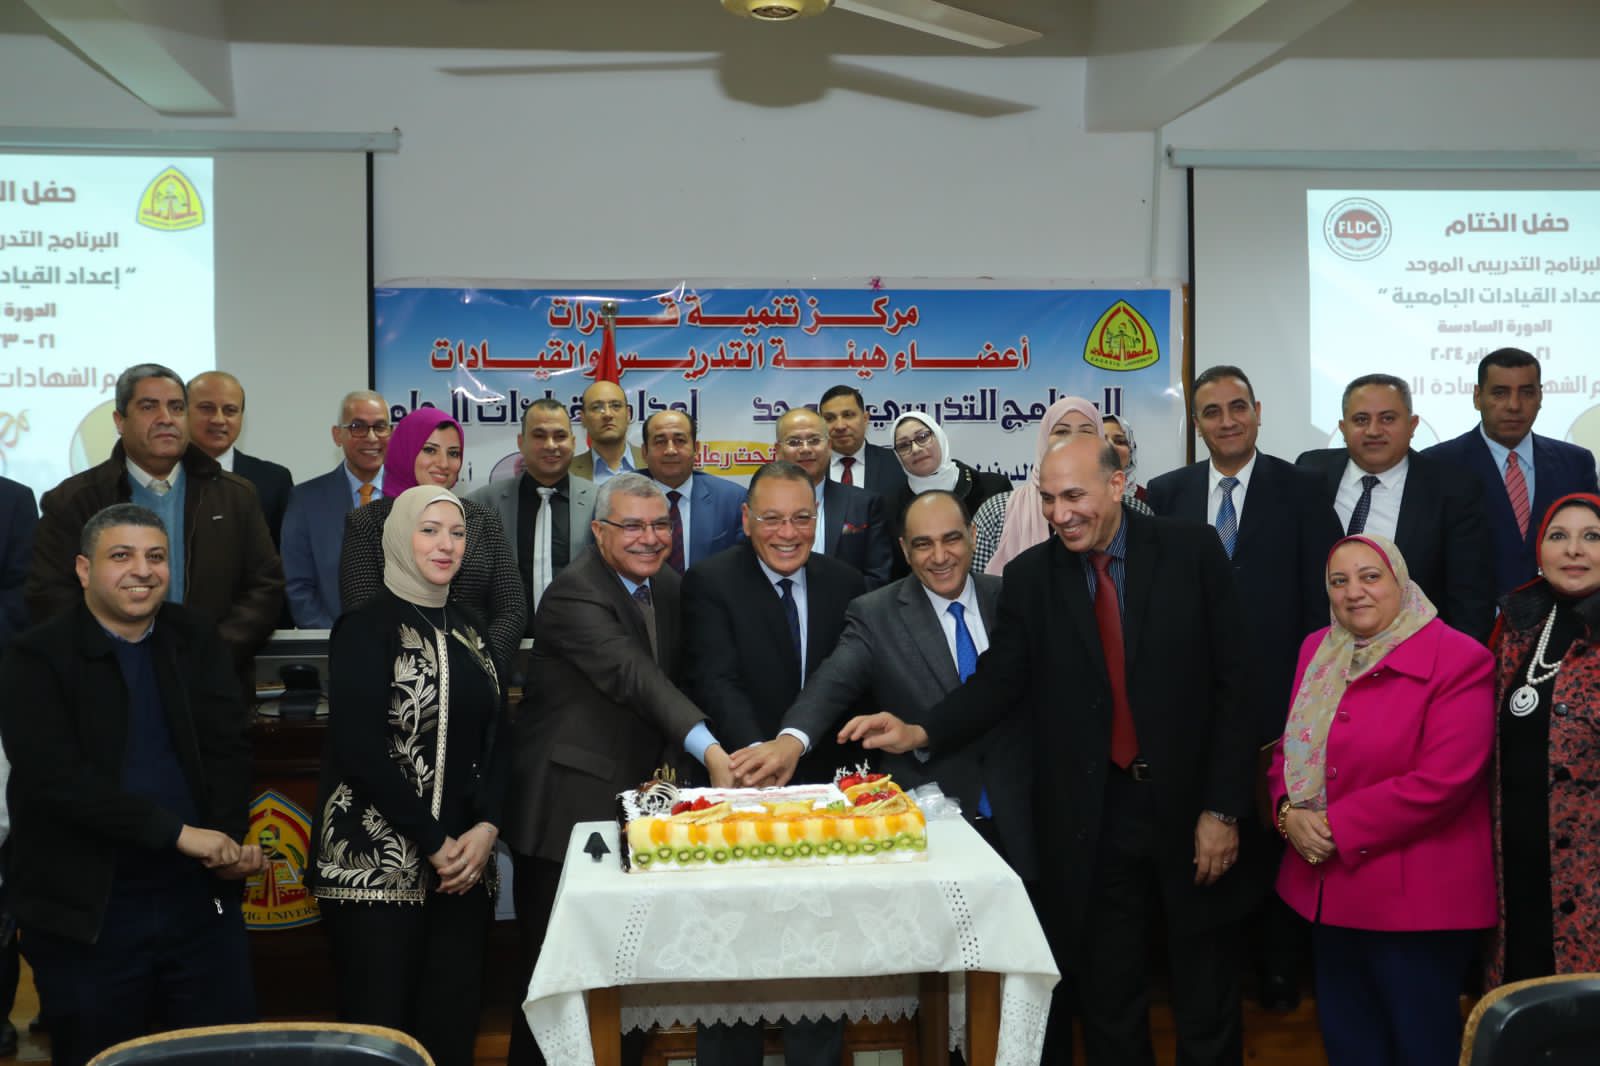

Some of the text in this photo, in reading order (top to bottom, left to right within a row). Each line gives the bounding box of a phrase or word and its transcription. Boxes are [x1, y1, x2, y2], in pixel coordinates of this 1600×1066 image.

[22, 180, 76, 206] حفل
[1338, 220, 1377, 234] FLDC
[1445, 212, 1569, 236] حفل الختام
[47, 231, 118, 253] البرنامج
[1405, 256, 1464, 274] الموحد
[1544, 256, 1600, 275] لبرنامج
[1392, 288, 1474, 308] الجامعية
[1479, 288, 1556, 308] القيادات
[1560, 288, 1600, 303] عداد
[4, 302, 56, 322] الدورة
[686, 294, 800, 335] تنمية
[803, 296, 919, 335] مركز
[1437, 319, 1552, 336] الدورة السادسة
[771, 336, 890, 378] هيئة
[894, 335, 1031, 373] أعضاء
[734, 447, 776, 465] تحت
